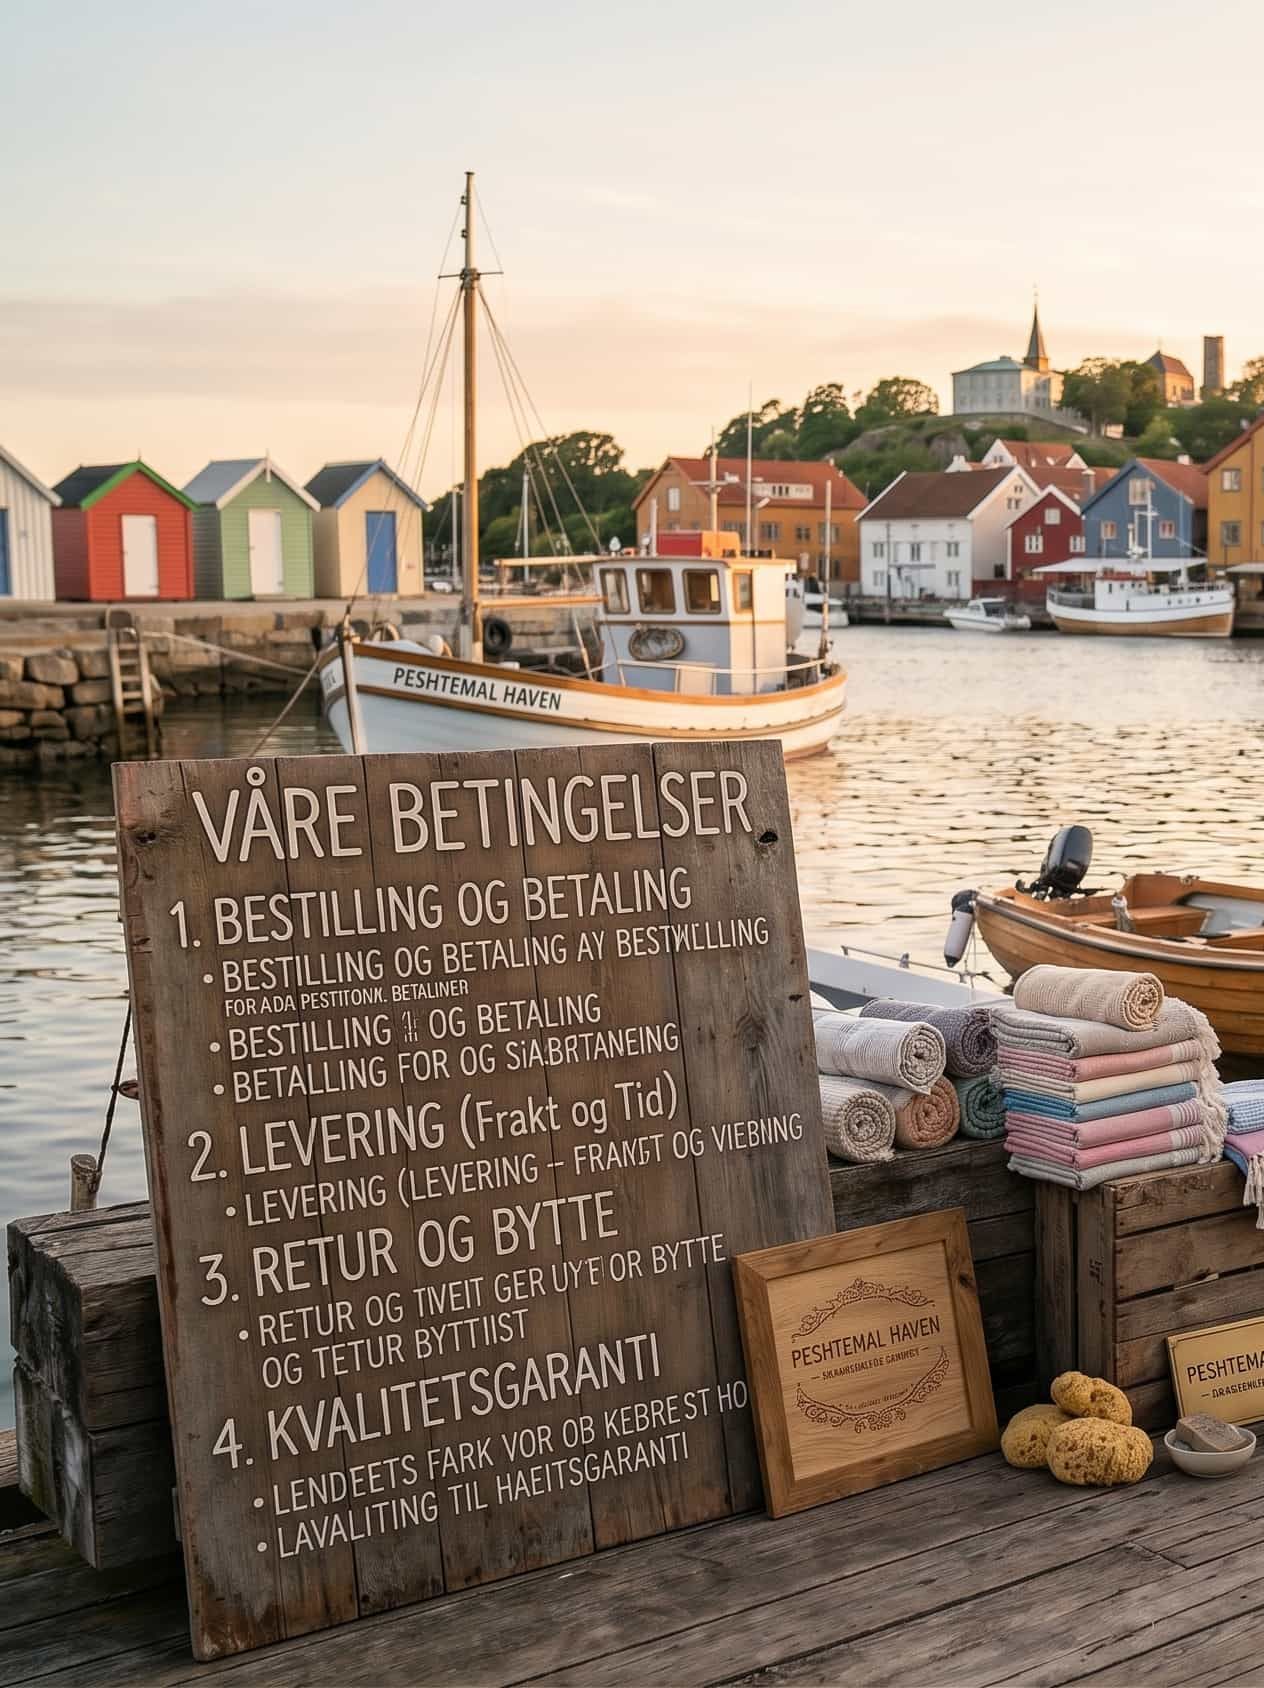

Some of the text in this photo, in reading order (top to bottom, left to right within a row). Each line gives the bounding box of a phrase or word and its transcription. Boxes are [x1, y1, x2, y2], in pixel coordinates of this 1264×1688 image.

[393, 667, 561, 711] PESHTEMAL HAVEN
[191, 766, 754, 863] VÅRE BETINGELSER
[168, 866, 693, 949] 1. BESTILLING OG BETALING
[222, 949, 384, 993] BESTILLING
[394, 945, 432, 978] OG
[442, 934, 568, 975] BETALING
[225, 998, 257, 1017] FOR
[392, 979, 469, 1002] BETALINER
[228, 1014, 393, 1061] BESTILLING
[428, 1006, 467, 1040] OG
[476, 993, 602, 1037] BETALING
[232, 1054, 388, 1104] BETALLING
[397, 1044, 452, 1084] FOR
[458, 1041, 497, 1076] OG
[186, 1070, 678, 1183] 2. LEVERING (Frakt og Tid)
[244, 1174, 387, 1228] LEVERING
[397, 1152, 540, 1208] (LEVERING
[672, 1128, 705, 1160] OG
[199, 1190, 620, 1306] 3. RETUR OG BYTTE
[257, 1301, 355, 1347] RETUR
[365, 1293, 405, 1329] OG
[494, 1266, 547, 1303] GER
[651, 1233, 727, 1275] BYTTE
[261, 1355, 303, 1389] OG
[311, 1333, 405, 1380] TETUR
[791, 1329, 887, 1369] PESHTEMAL
[889, 1315, 941, 1345] HAVEN
[212, 1332, 662, 1470] 4. KVALITETSGARANTI
[273, 1455, 419, 1516] LENDEETS
[426, 1436, 495, 1486] FARK
[501, 1425, 555, 1463] VOR
[561, 1416, 596, 1449] OB
[277, 1431, 690, 1560] LAVALITING TIL HAEITSGARANTI
